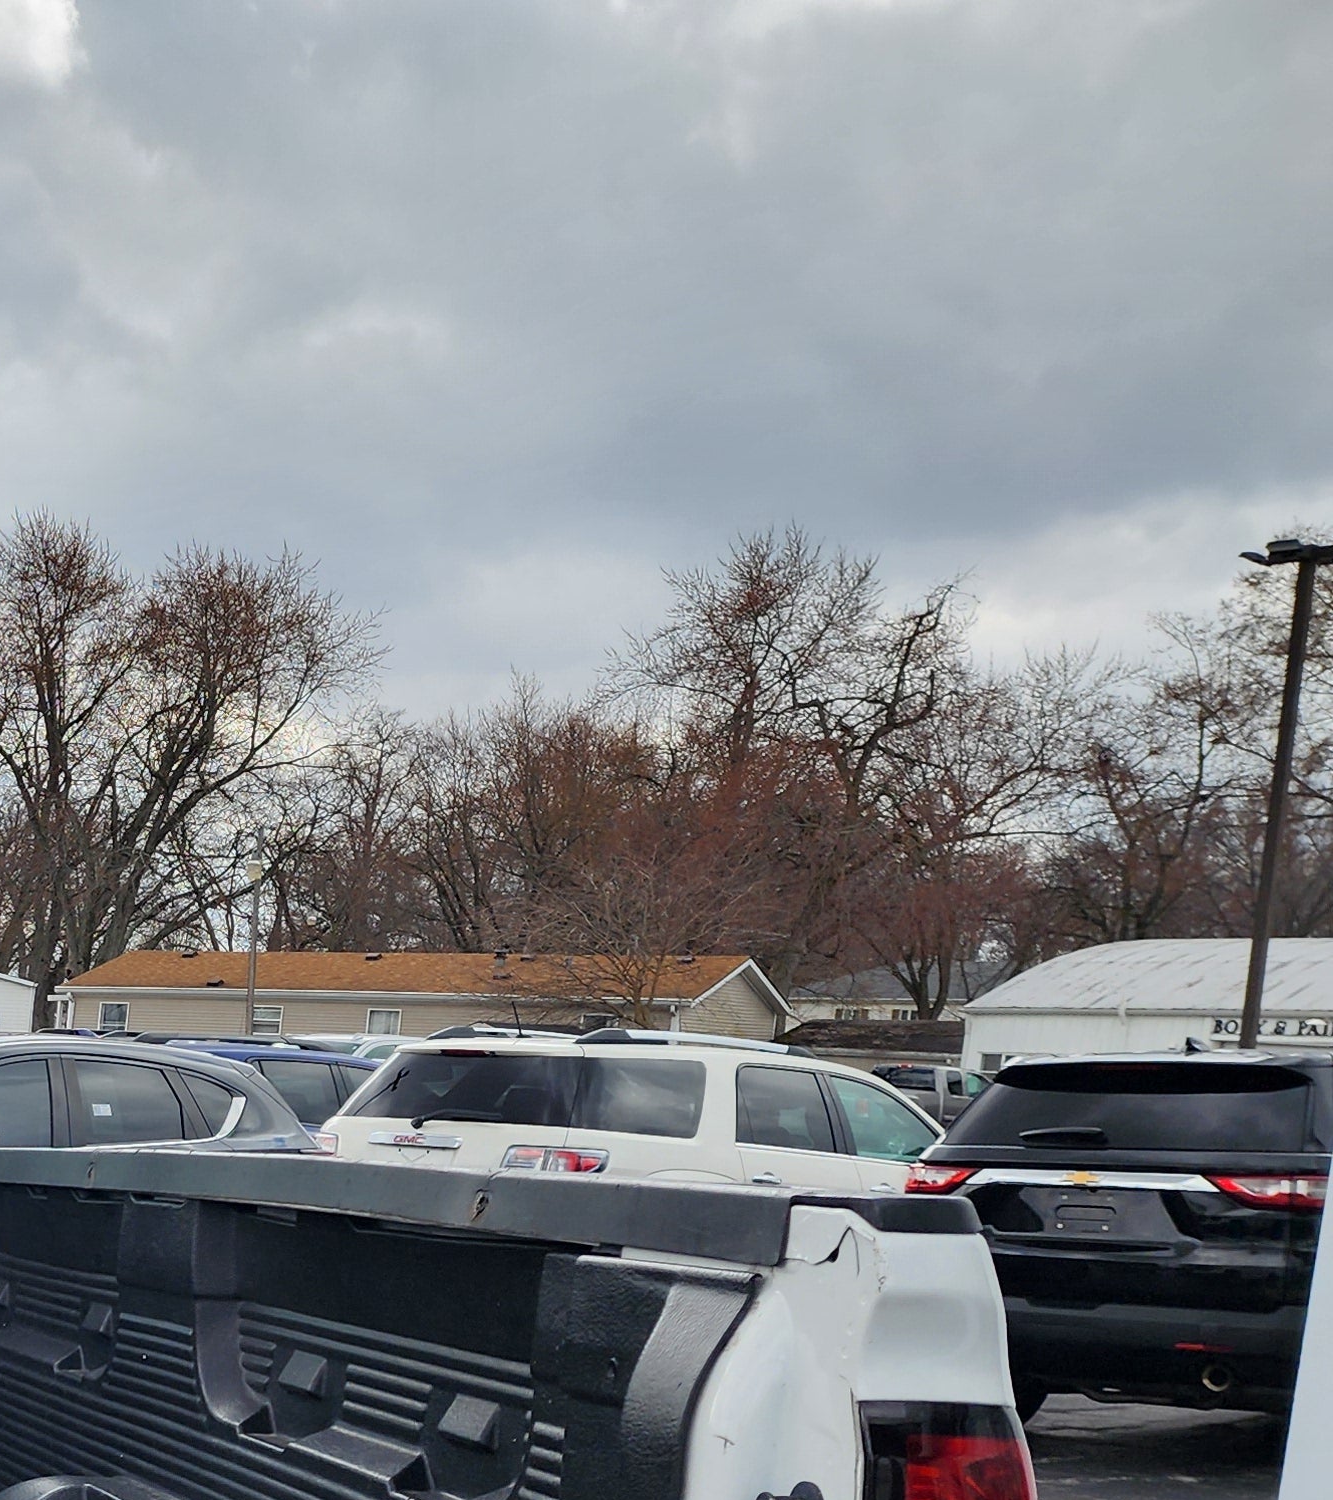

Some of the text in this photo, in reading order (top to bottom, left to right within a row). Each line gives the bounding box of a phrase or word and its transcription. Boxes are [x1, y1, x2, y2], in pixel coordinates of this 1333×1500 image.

[1214, 1019, 1333, 1036] BOY & PAI
[393, 1135, 426, 1144] GMC
